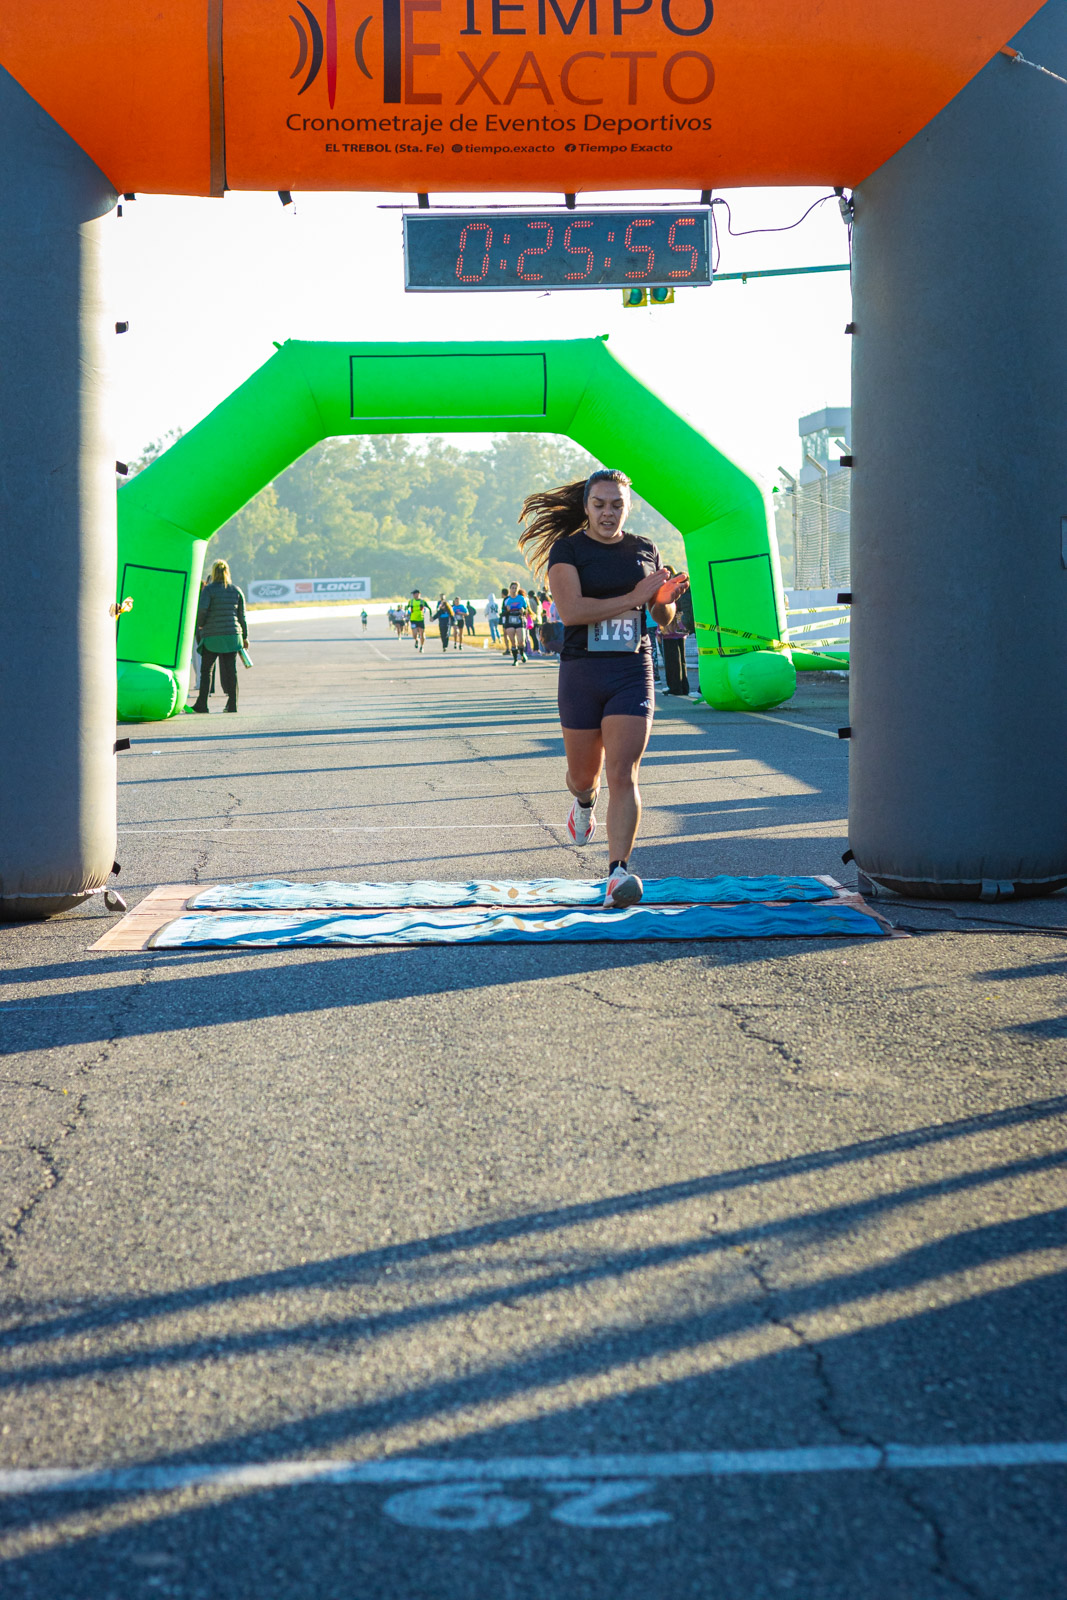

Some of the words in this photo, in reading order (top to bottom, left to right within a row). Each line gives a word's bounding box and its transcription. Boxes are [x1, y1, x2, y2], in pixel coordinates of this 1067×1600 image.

[286, 113, 443, 135] Cronometraje
[449, 113, 478, 131] de
[486, 114, 576, 131] Eventos
[584, 114, 712, 135] Deportivos
[325, 143, 340, 152] EL
[342, 143, 391, 153] TREBOL
[395, 143, 423, 154] (Sta.
[426, 143, 445, 154] Fe)
[465, 144, 555, 155] tiempo.exacto
[578, 143, 627, 154] Tiempo
[631, 143, 673, 153] Exacto
[455, 218, 699, 282] 0:25:55
[316, 582, 362, 592] LONG
[600, 619, 634, 641] 175
